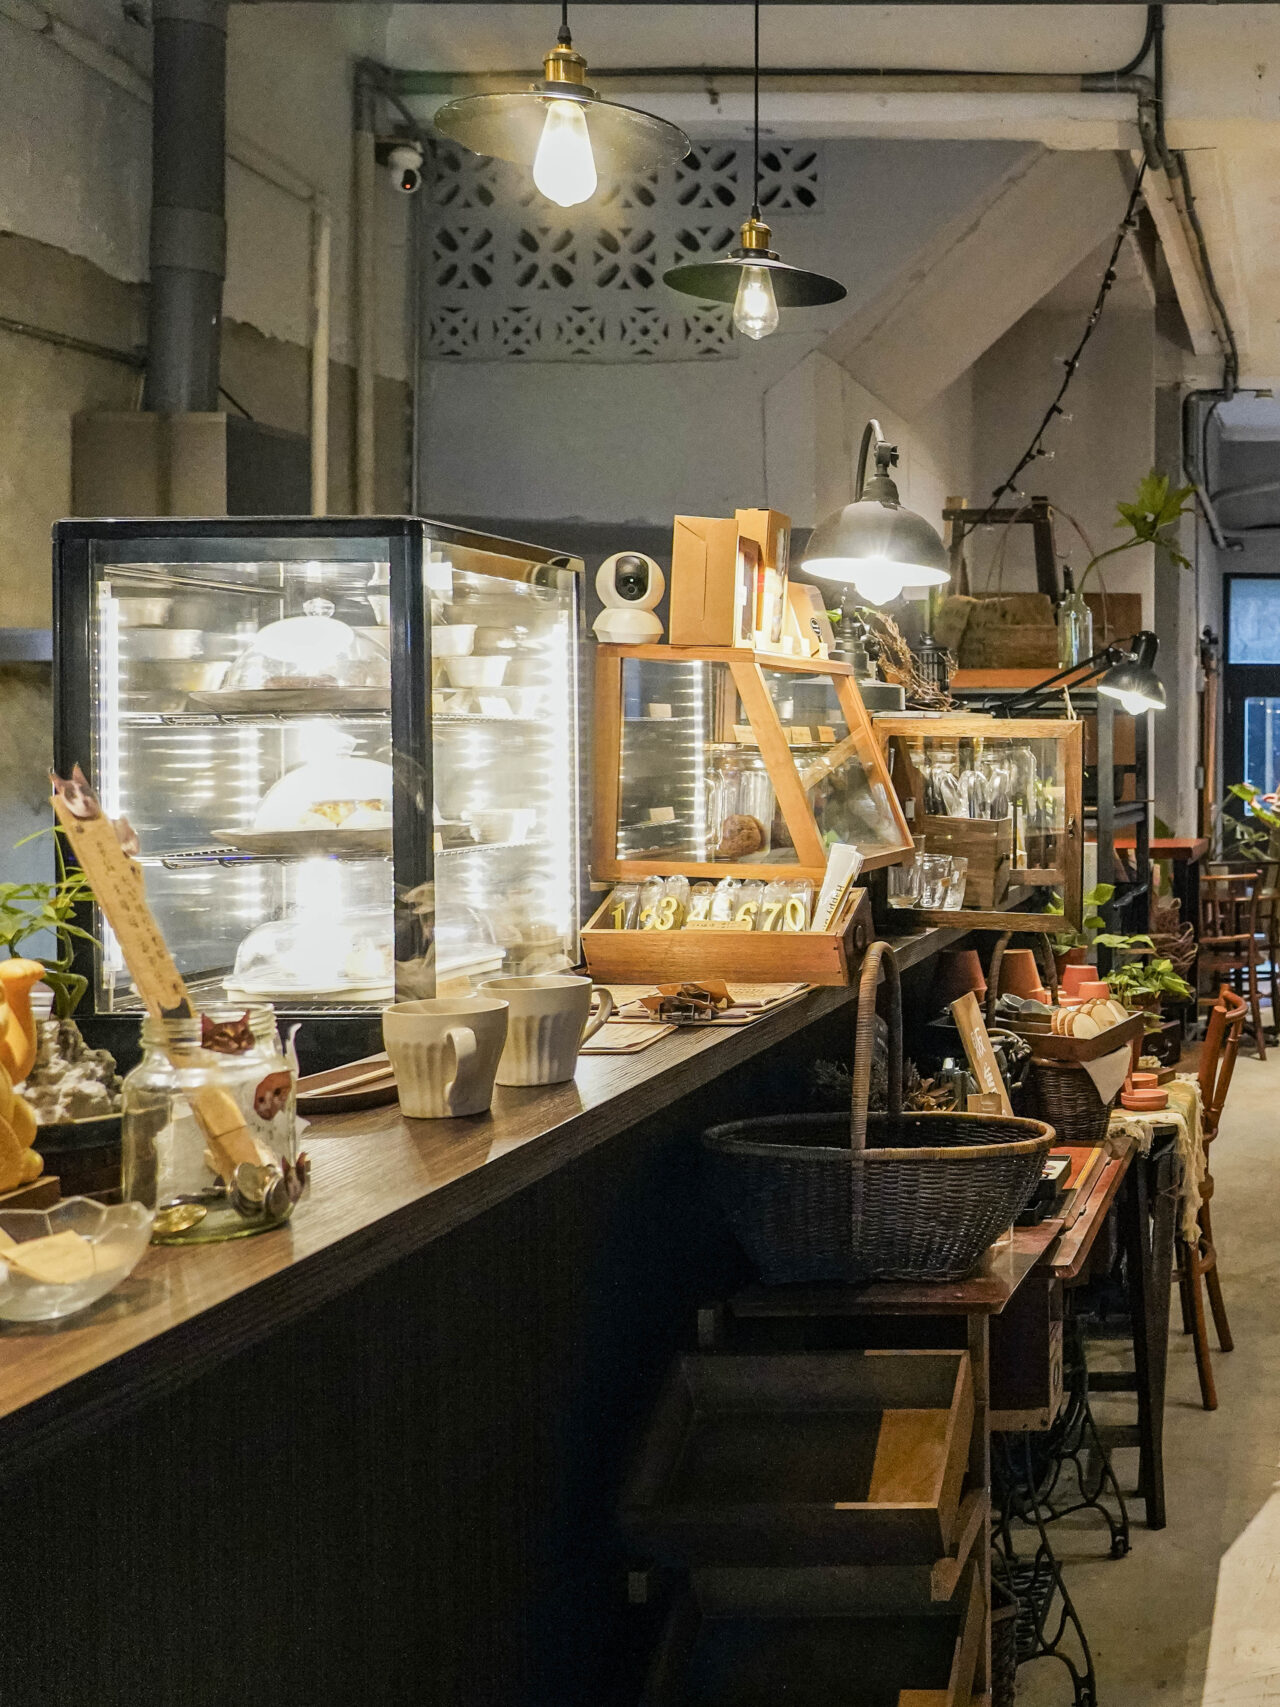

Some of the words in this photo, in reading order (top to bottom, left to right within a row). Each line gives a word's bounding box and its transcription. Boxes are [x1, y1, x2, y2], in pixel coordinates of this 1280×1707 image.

[612, 901, 625, 930] 1
[655, 896, 678, 930] 3
[735, 901, 757, 931] 6
[762, 902, 782, 931] 7
[785, 898, 805, 931] 0
